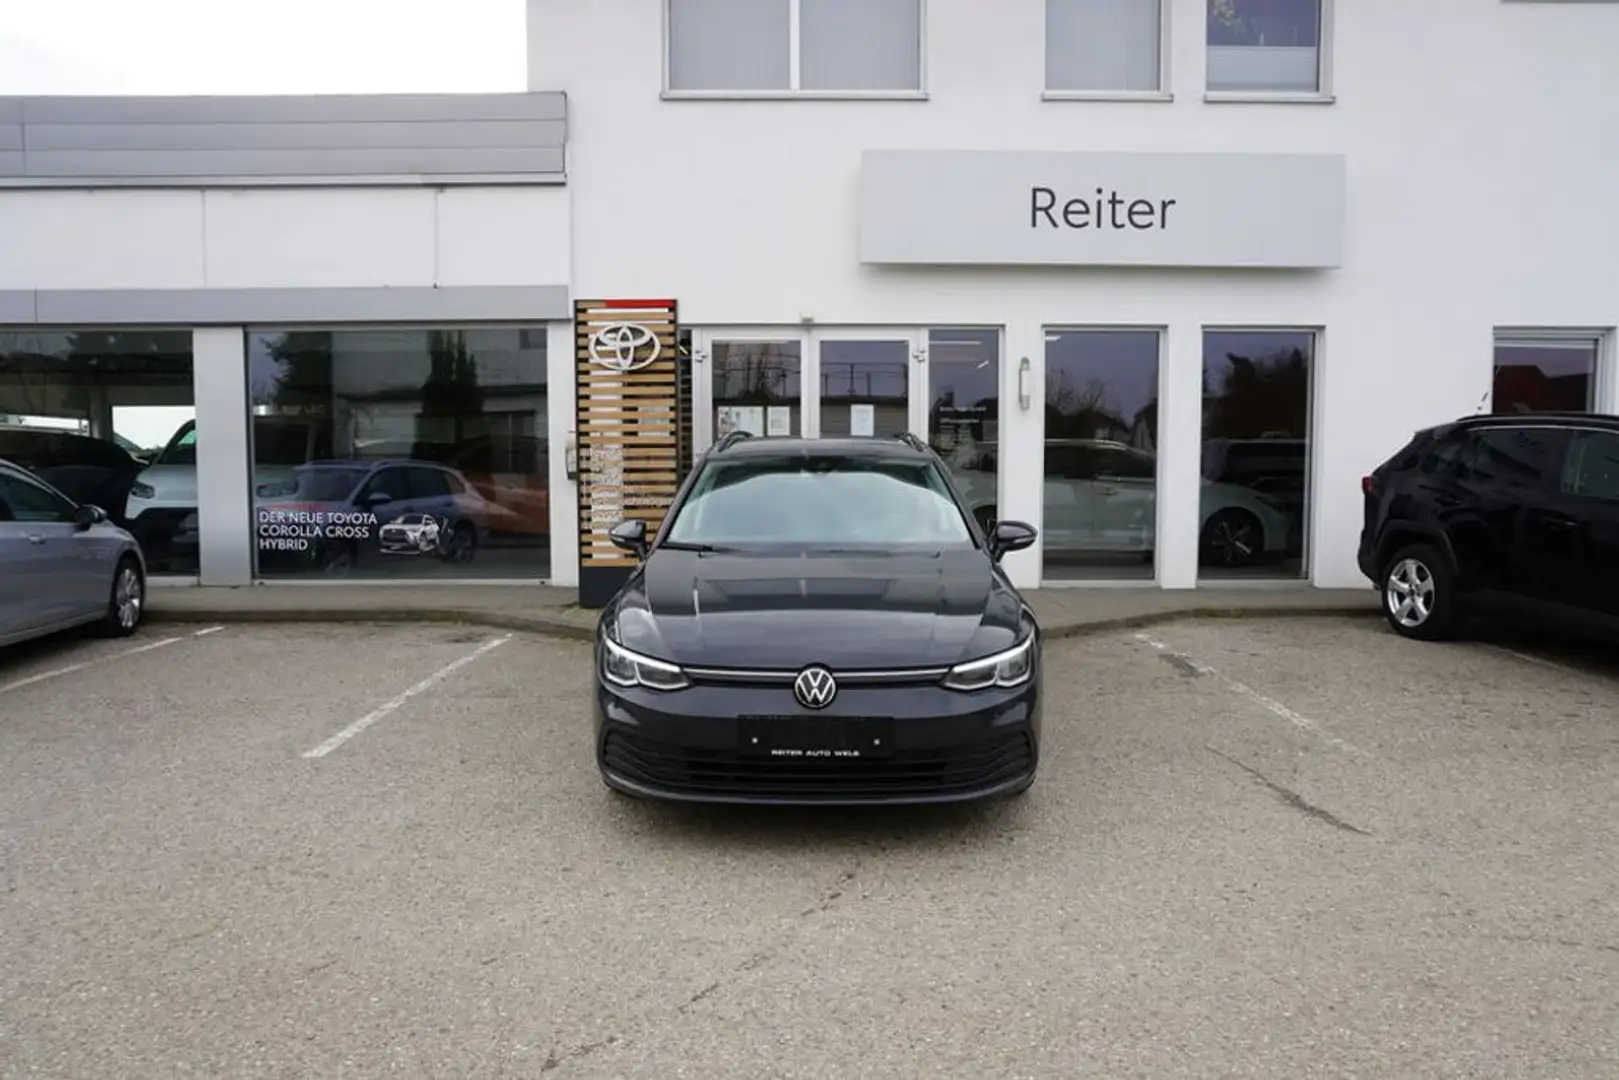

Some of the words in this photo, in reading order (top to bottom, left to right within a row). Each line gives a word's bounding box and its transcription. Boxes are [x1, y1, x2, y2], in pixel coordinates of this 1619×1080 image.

[1031, 187, 1176, 229] Reiter
[259, 511, 286, 523] DER
[289, 512, 324, 524] NEUE
[327, 512, 377, 525] TOYOTA
[259, 524, 322, 537] COROLLA
[325, 526, 369, 538] CROSS
[259, 538, 308, 551] HYBRID
[805, 749, 831, 757] AUTO
